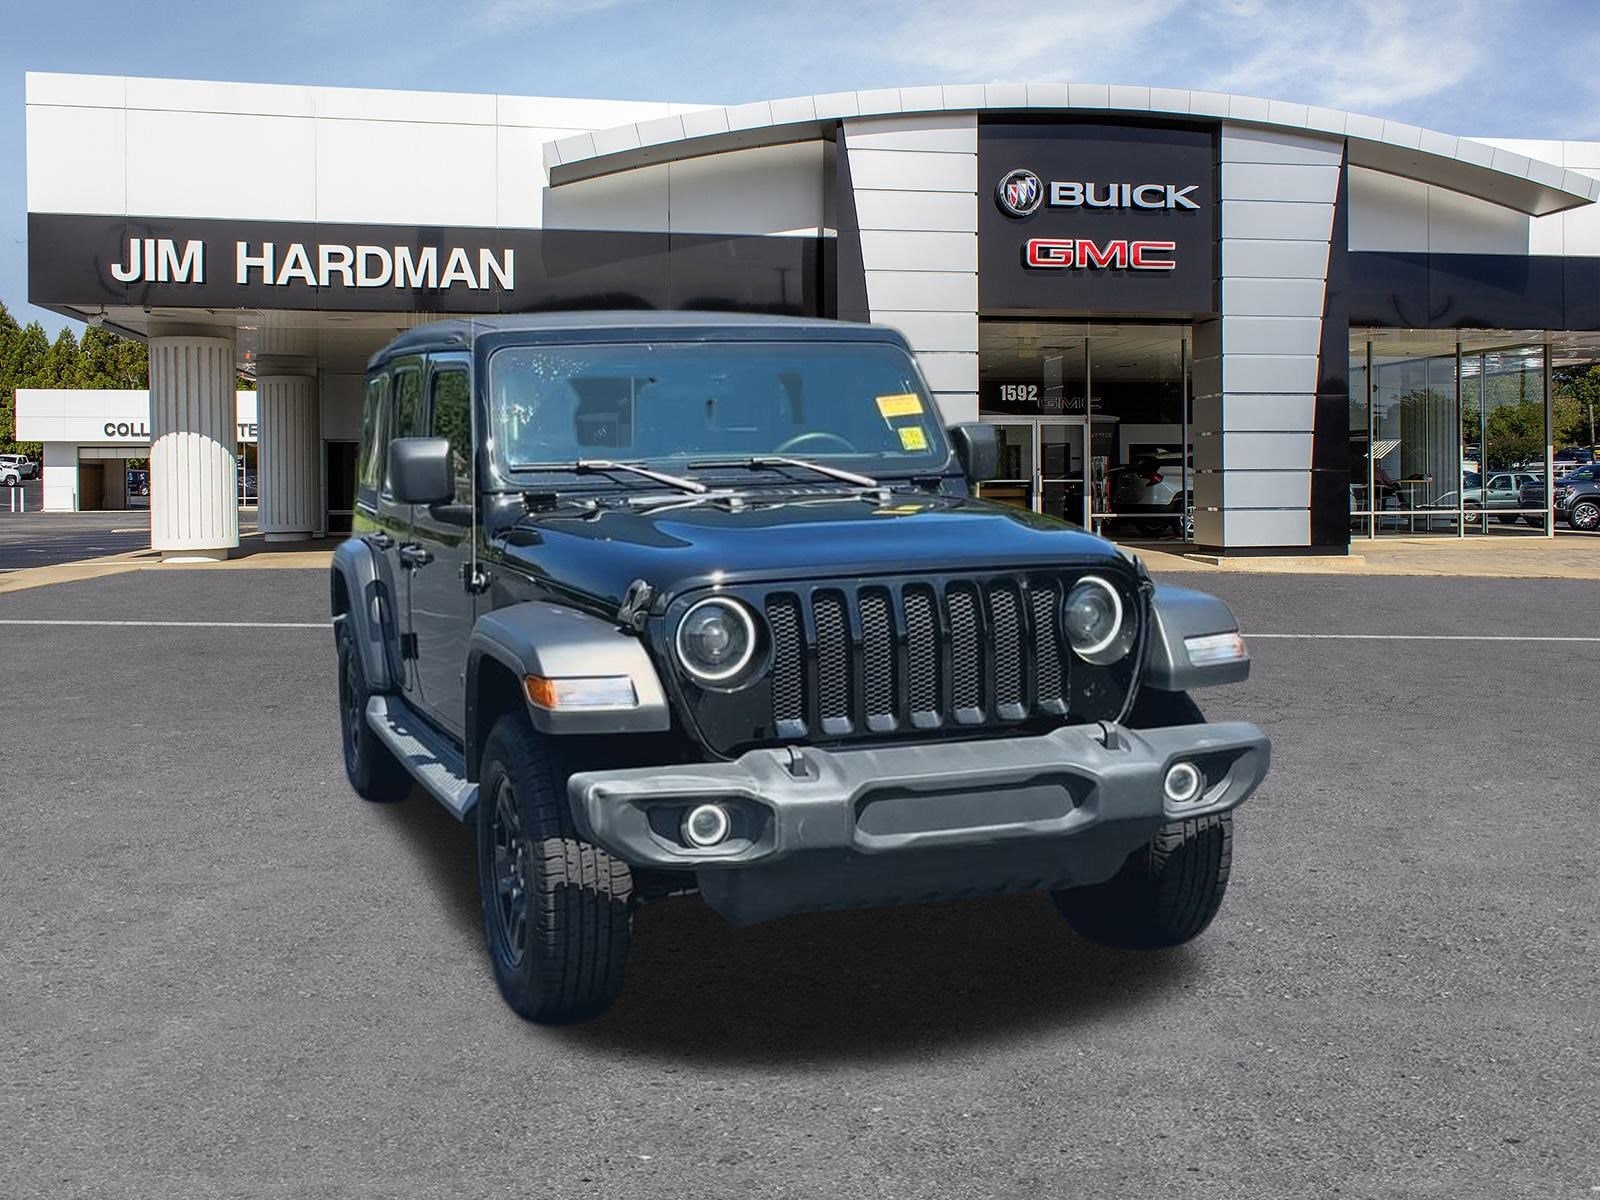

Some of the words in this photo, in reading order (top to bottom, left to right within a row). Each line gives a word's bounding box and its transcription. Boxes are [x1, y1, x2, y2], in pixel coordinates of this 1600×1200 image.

[1050, 181, 1201, 209] BUICK
[111, 238, 203, 283] JIM
[236, 241, 515, 290] HARDMAN
[1026, 238, 1176, 269] GMC
[1000, 384, 1038, 401] 1592
[1037, 396, 1102, 409] GMC
